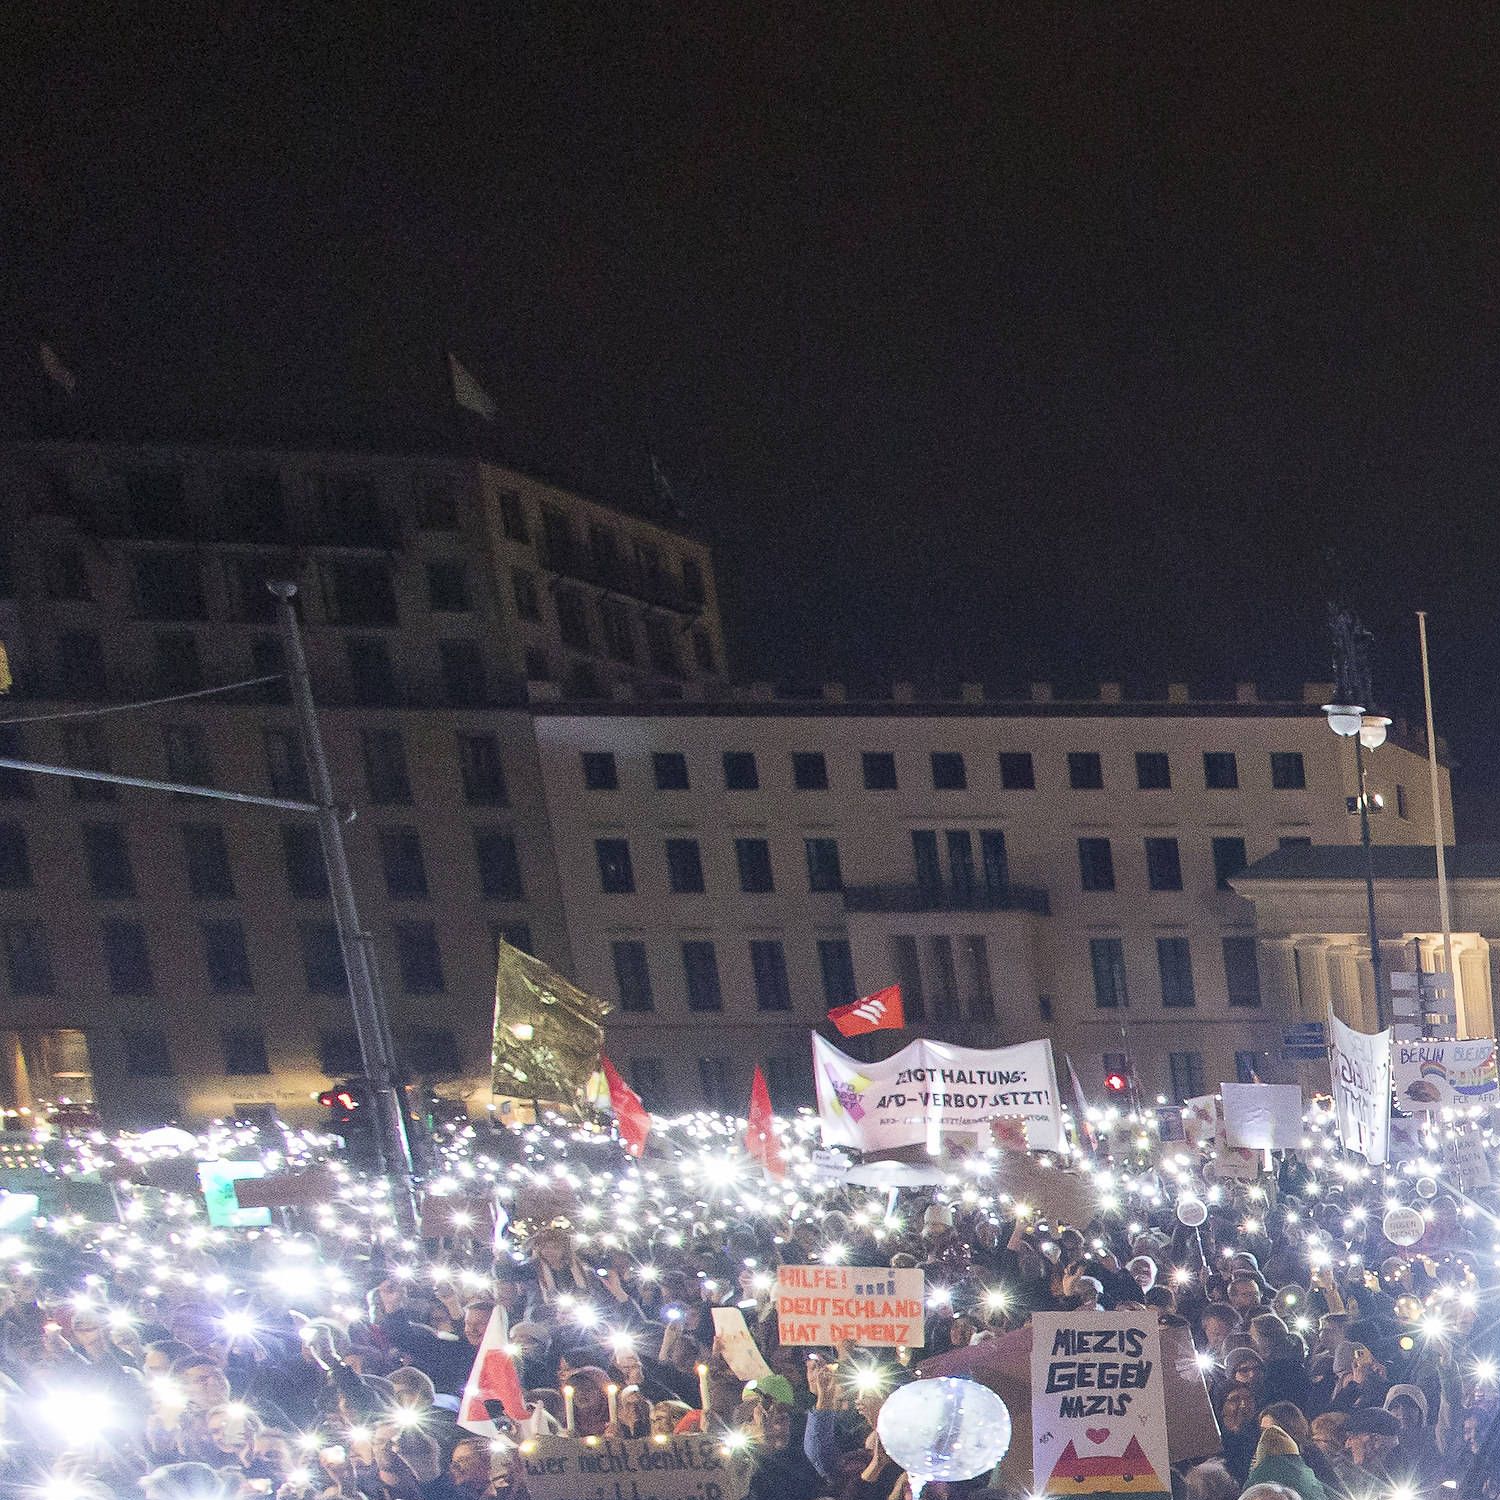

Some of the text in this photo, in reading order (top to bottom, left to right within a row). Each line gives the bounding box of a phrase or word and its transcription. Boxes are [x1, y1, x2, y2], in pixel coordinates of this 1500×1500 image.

[1400, 1047, 1444, 1065] BERLIN
[895, 1068, 1028, 1085] ZEIGT HALTUNG:
[989, 1090, 1050, 1107] JETZT!
[779, 1268, 847, 1290] HILFE!
[780, 1297, 922, 1319] DEUTSCHLAND
[780, 1322, 911, 1344] HAT DEMENZ
[1051, 1328, 1148, 1358] MIEZIS
[1045, 1360, 1152, 1393] GEGEN
[1059, 1393, 1133, 1418] NAZIS
[638, 1440, 699, 1471] denkt
